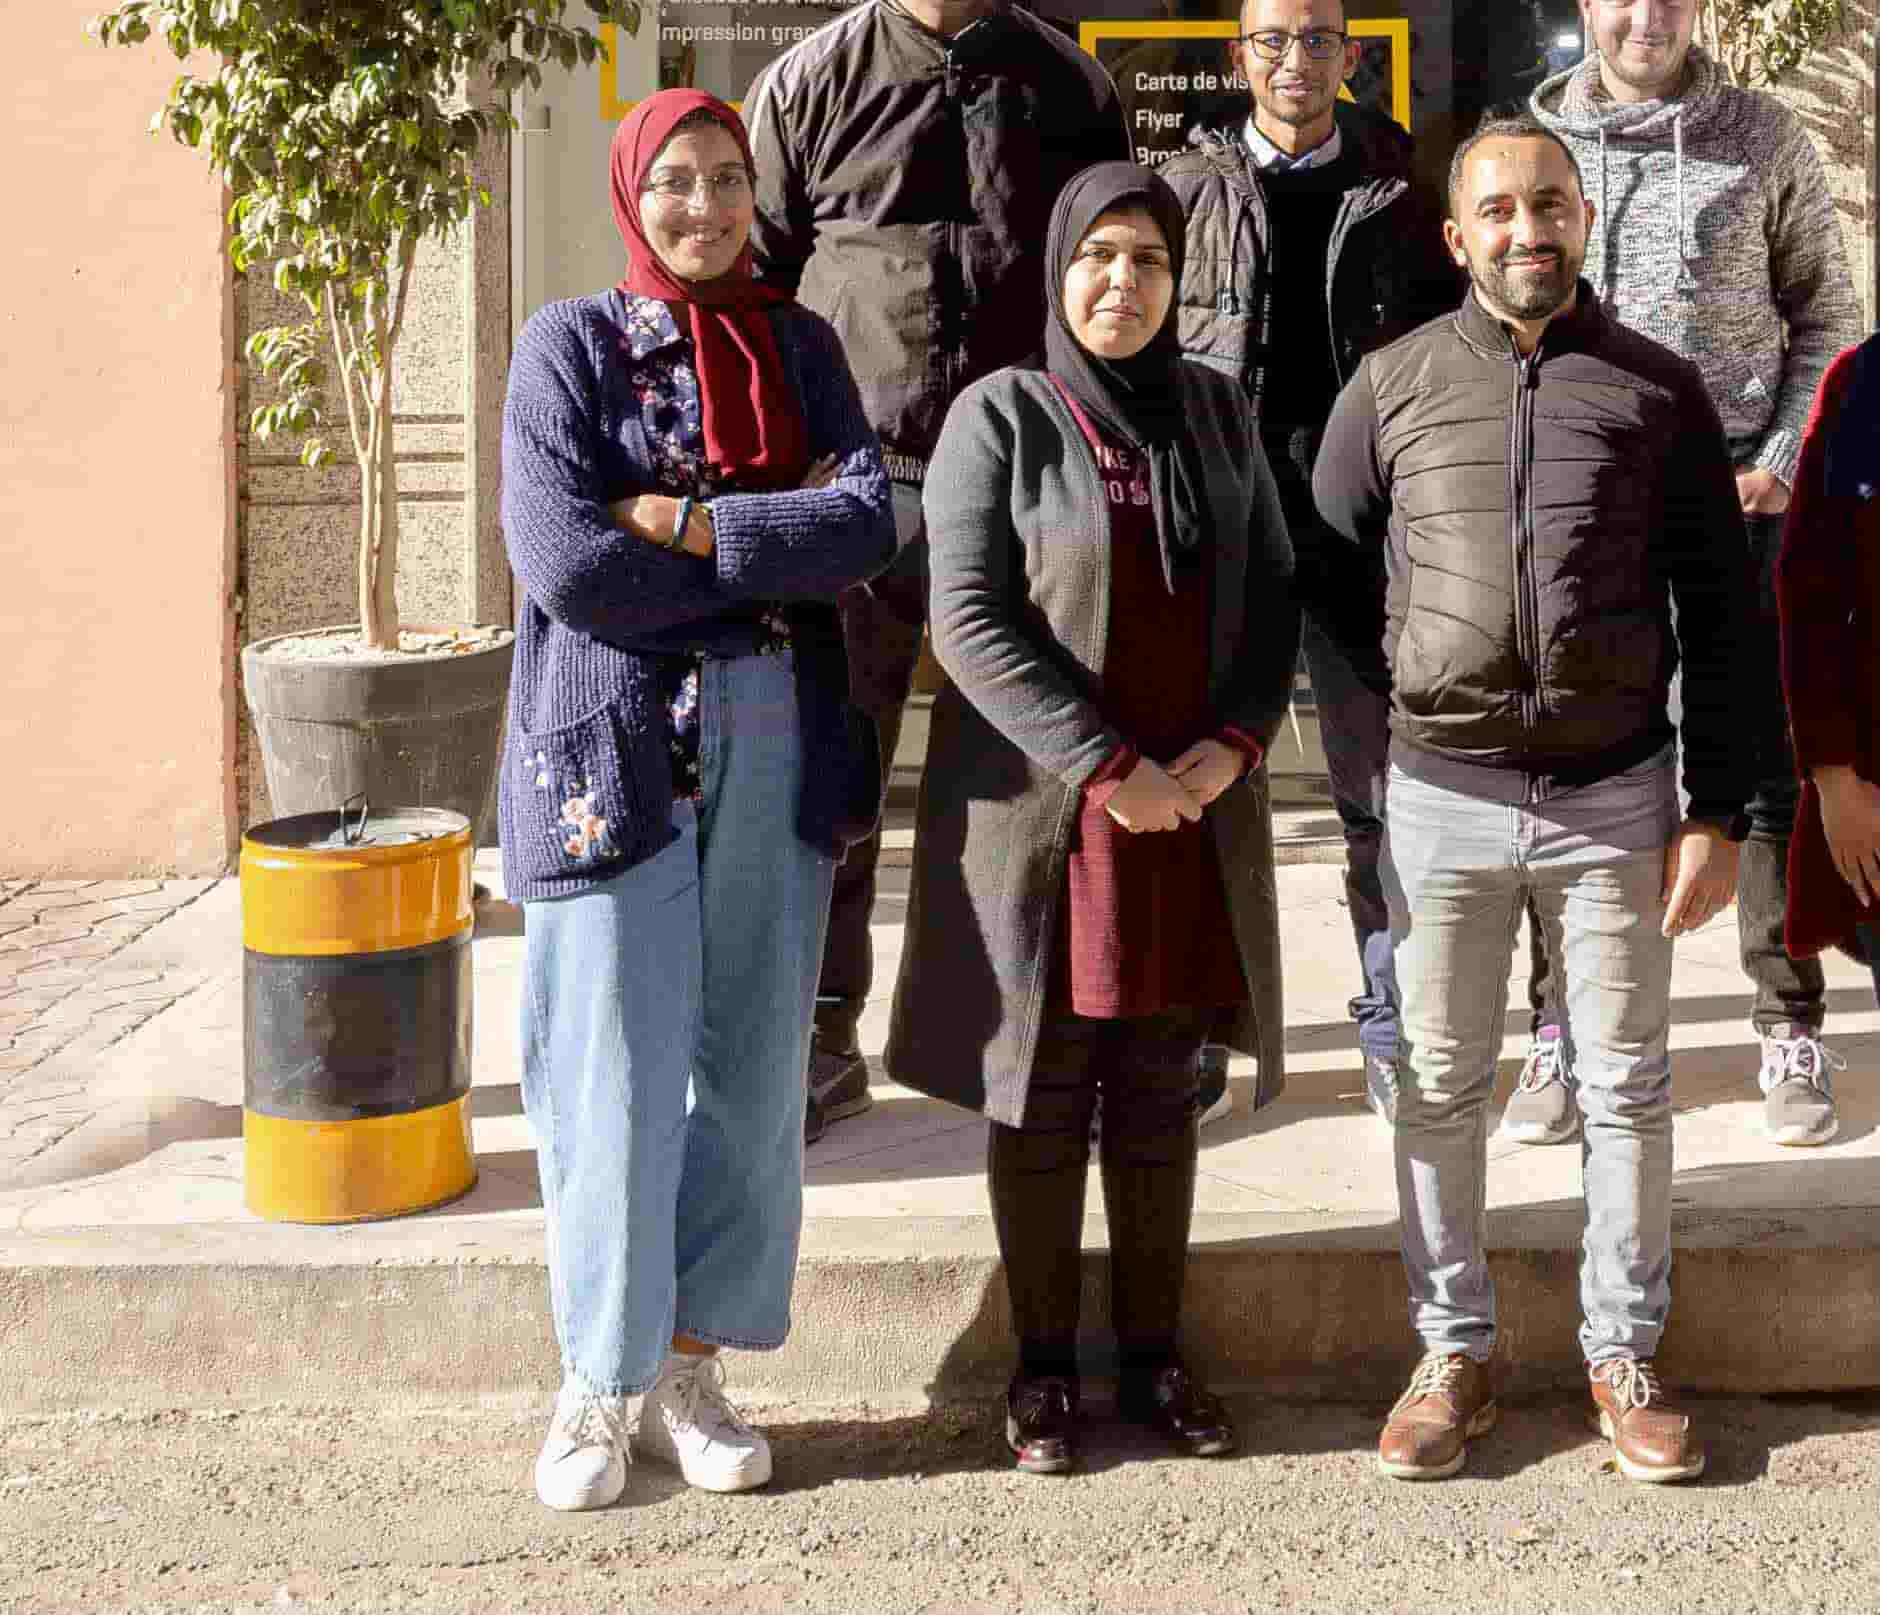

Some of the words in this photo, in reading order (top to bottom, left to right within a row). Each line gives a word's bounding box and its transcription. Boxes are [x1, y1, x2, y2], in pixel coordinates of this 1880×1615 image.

[656, 23, 765, 46] Impression
[1136, 72, 1188, 91] Carte
[1193, 72, 1217, 90] de
[1136, 109, 1184, 134] Flyer
